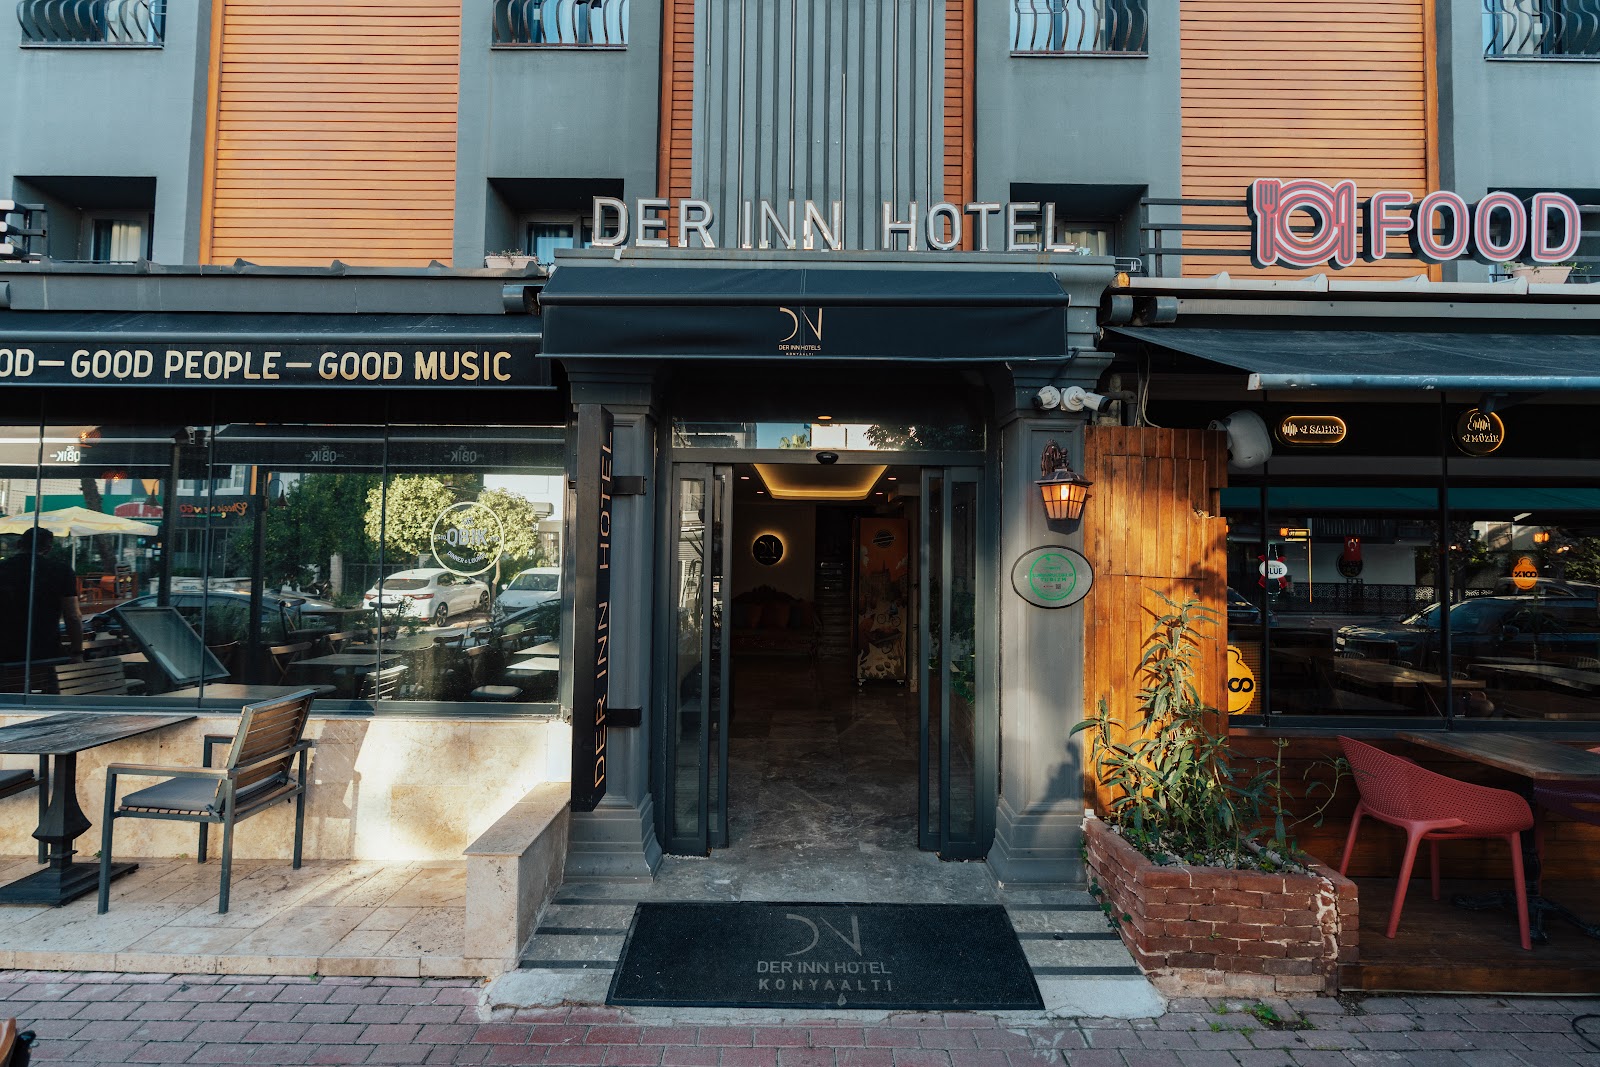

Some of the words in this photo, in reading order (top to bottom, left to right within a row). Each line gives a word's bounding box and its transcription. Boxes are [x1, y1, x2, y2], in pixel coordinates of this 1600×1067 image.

[592, 196, 715, 248] DER
[742, 200, 842, 250] INN
[882, 201, 1076, 252] HOTEL
[1370, 190, 1581, 263] FOOD
[71, 349, 154, 379] GOOD
[164, 350, 282, 380] PEOPLE
[318, 351, 403, 381] GOOD
[414, 351, 511, 381] MUSIC
[599, 431, 612, 570] HOTEL
[446, 527, 488, 548] QBIK
[1266, 566, 1283, 575] LUE
[597, 601, 608, 679] INN
[594, 693, 606, 788] DER
[757, 960, 793, 974] DER
[798, 961, 829, 974] INN
[835, 961, 892, 974] HOTEL
[758, 978, 892, 991] KONYAALTI
